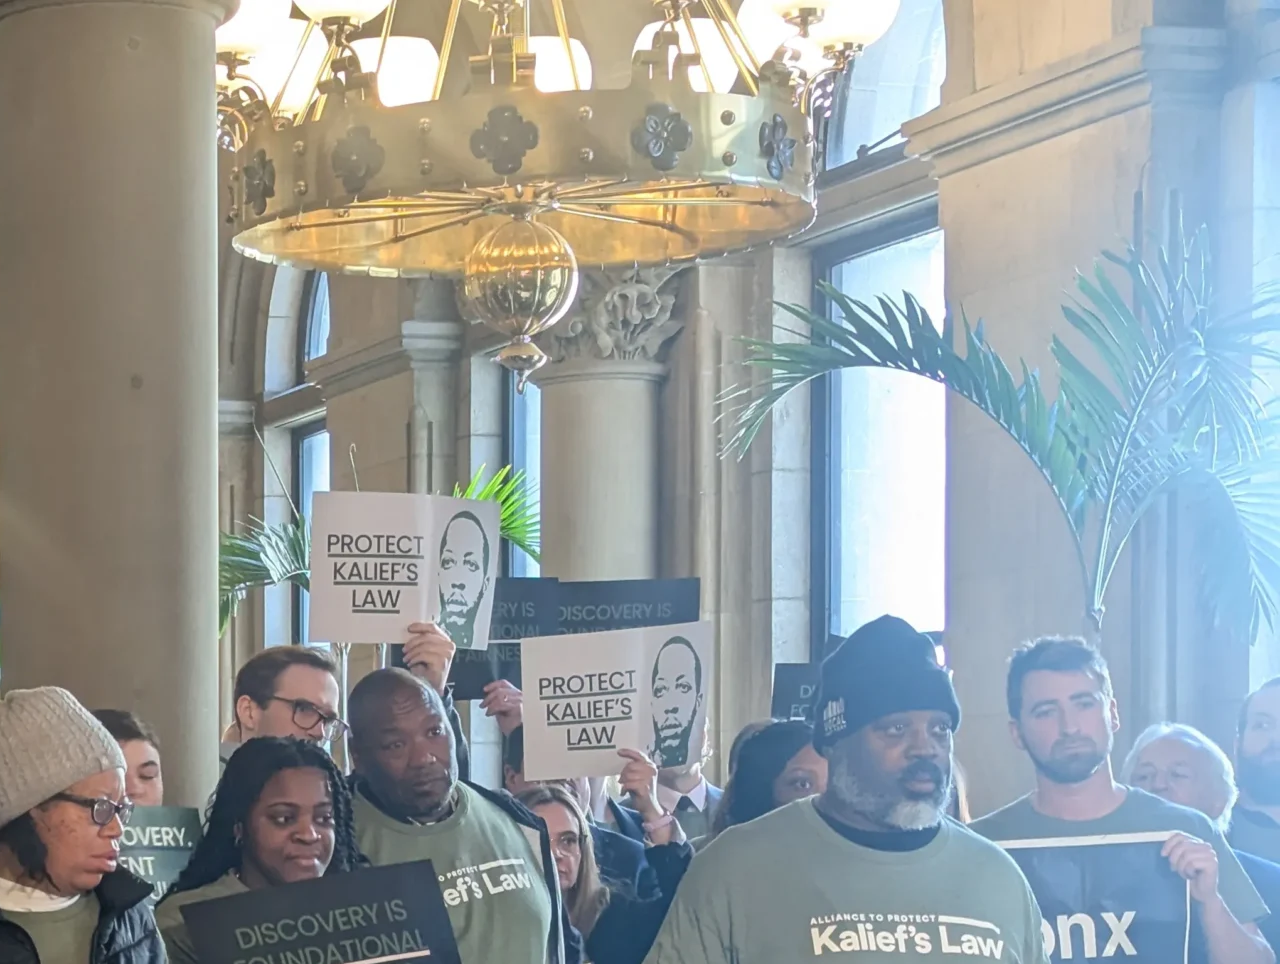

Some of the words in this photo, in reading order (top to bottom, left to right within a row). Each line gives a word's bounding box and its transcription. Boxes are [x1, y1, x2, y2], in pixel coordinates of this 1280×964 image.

[327, 534, 424, 554] PROTECT
[333, 561, 418, 582] KALIEF'S
[352, 589, 401, 608] LAW
[657, 602, 672, 618] IS
[455, 647, 521, 663] FAIRNES
[539, 670, 636, 695] PROTECT
[547, 697, 632, 721] KALIEF'S
[567, 725, 616, 746] LAW
[121, 826, 193, 847] OVERY.
[446, 865, 478, 879] PROTECT
[482, 872, 531, 895] Law
[234, 903, 379, 950] DISCOVERY
[384, 899, 408, 922] IS
[810, 913, 866, 925] ALLIANCE
[869, 913, 884, 922] TO
[887, 914, 936, 923] PROTECT
[810, 922, 932, 956] Kalief's
[939, 925, 1004, 960] Law
